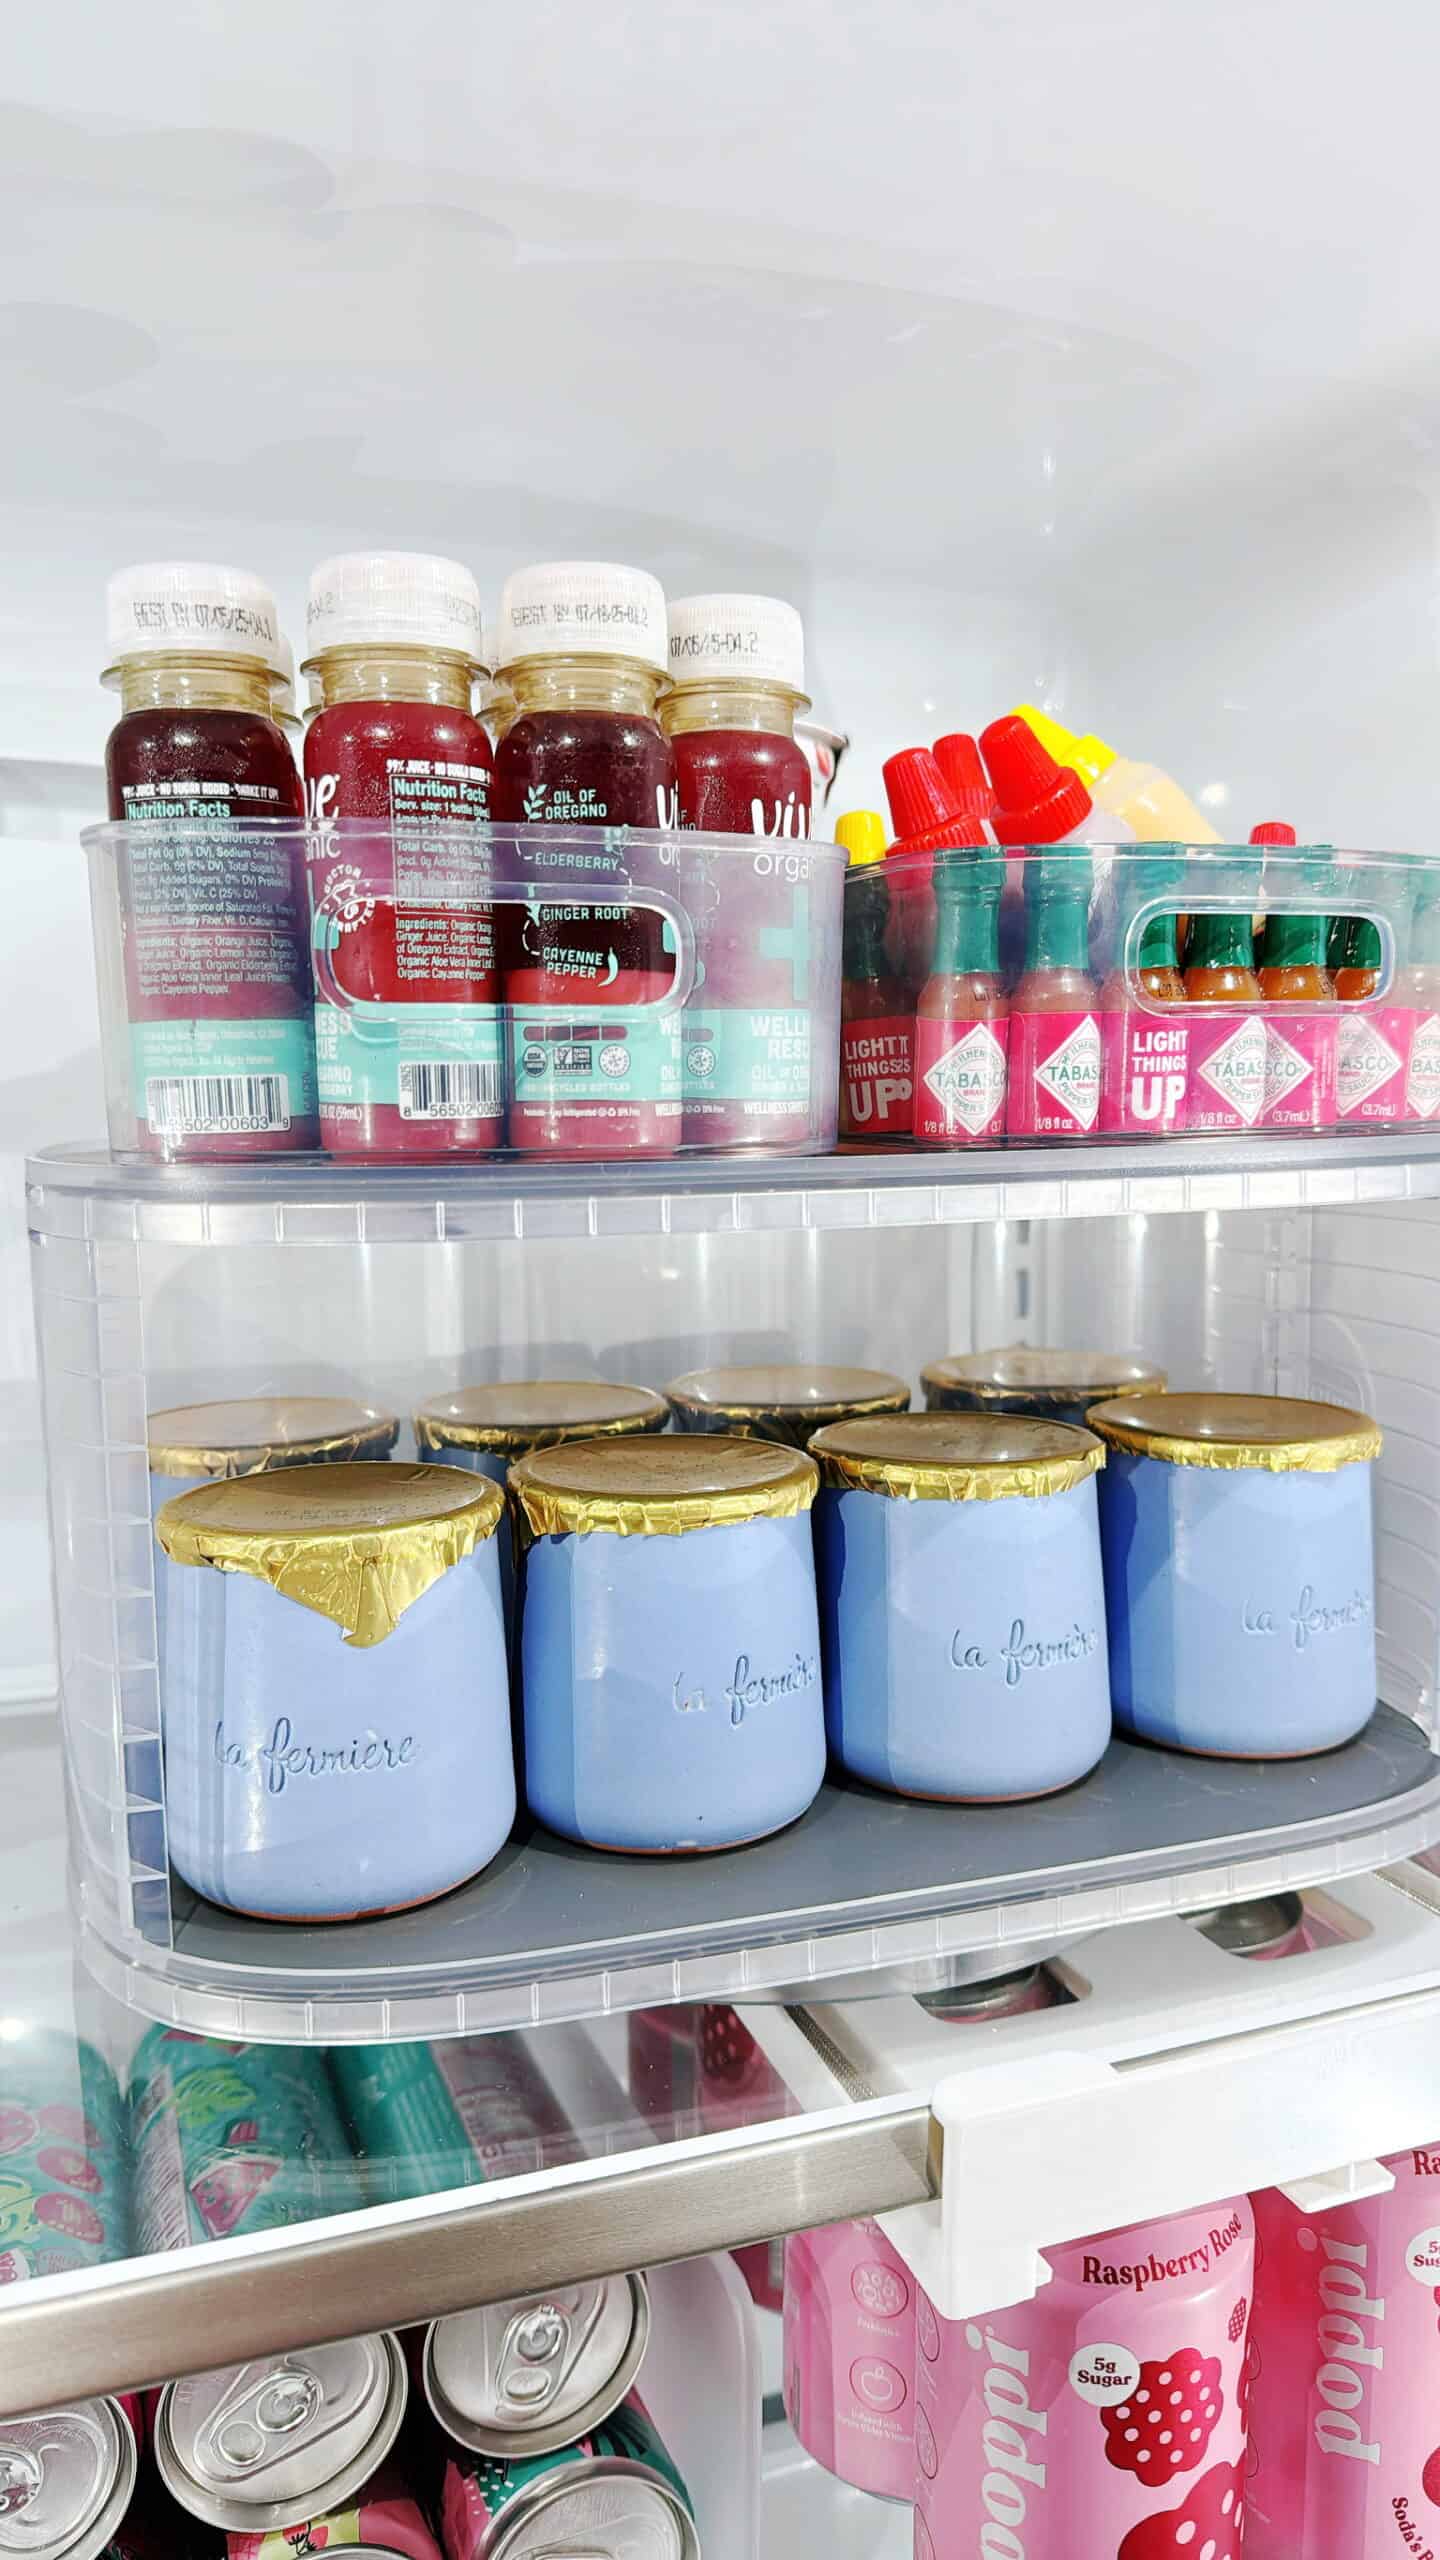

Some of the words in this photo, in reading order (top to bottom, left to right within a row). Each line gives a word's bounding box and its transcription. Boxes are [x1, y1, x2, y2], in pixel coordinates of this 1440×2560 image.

[393, 778, 457, 798] Nutrition
[460, 783, 487, 804] Facts
[553, 790, 575, 804] OIL
[579, 788, 597, 802] OF
[127, 800, 185, 819] Nutrition
[189, 799, 231, 818] Facts
[545, 803, 608, 819] OREGANO
[534, 851, 619, 871] ELDERBERRY
[543, 907, 590, 921] GINGER
[594, 907, 628, 920] ROOT
[396, 956, 431, 968] Organic
[543, 946, 604, 966] CAYENNE
[397, 968, 431, 980] Organic
[546, 962, 598, 980] PEPPER
[1132, 1029, 1188, 1053] LIGHT
[1131, 1054, 1187, 1073] THINGS
[1130, 1075, 1186, 1121] UP
[430, 1103, 474, 1117] 56502
[219, 1115, 269, 1130] 00603
[282, 1118, 289, 1129] 9
[951, 1628, 988, 1669] la
[213, 1720, 248, 1767] la
[263, 1716, 417, 1794] fermière
[1082, 2244, 1210, 2292] Raspberry
[1208, 2212, 1243, 2258] Rose
[1296, 2226, 1385, 2466] poppi
[1093, 2357, 1117, 2374] 5g
[1077, 2369, 1132, 2388] Sugar
[1391, 2496, 1424, 2553] Soda's
